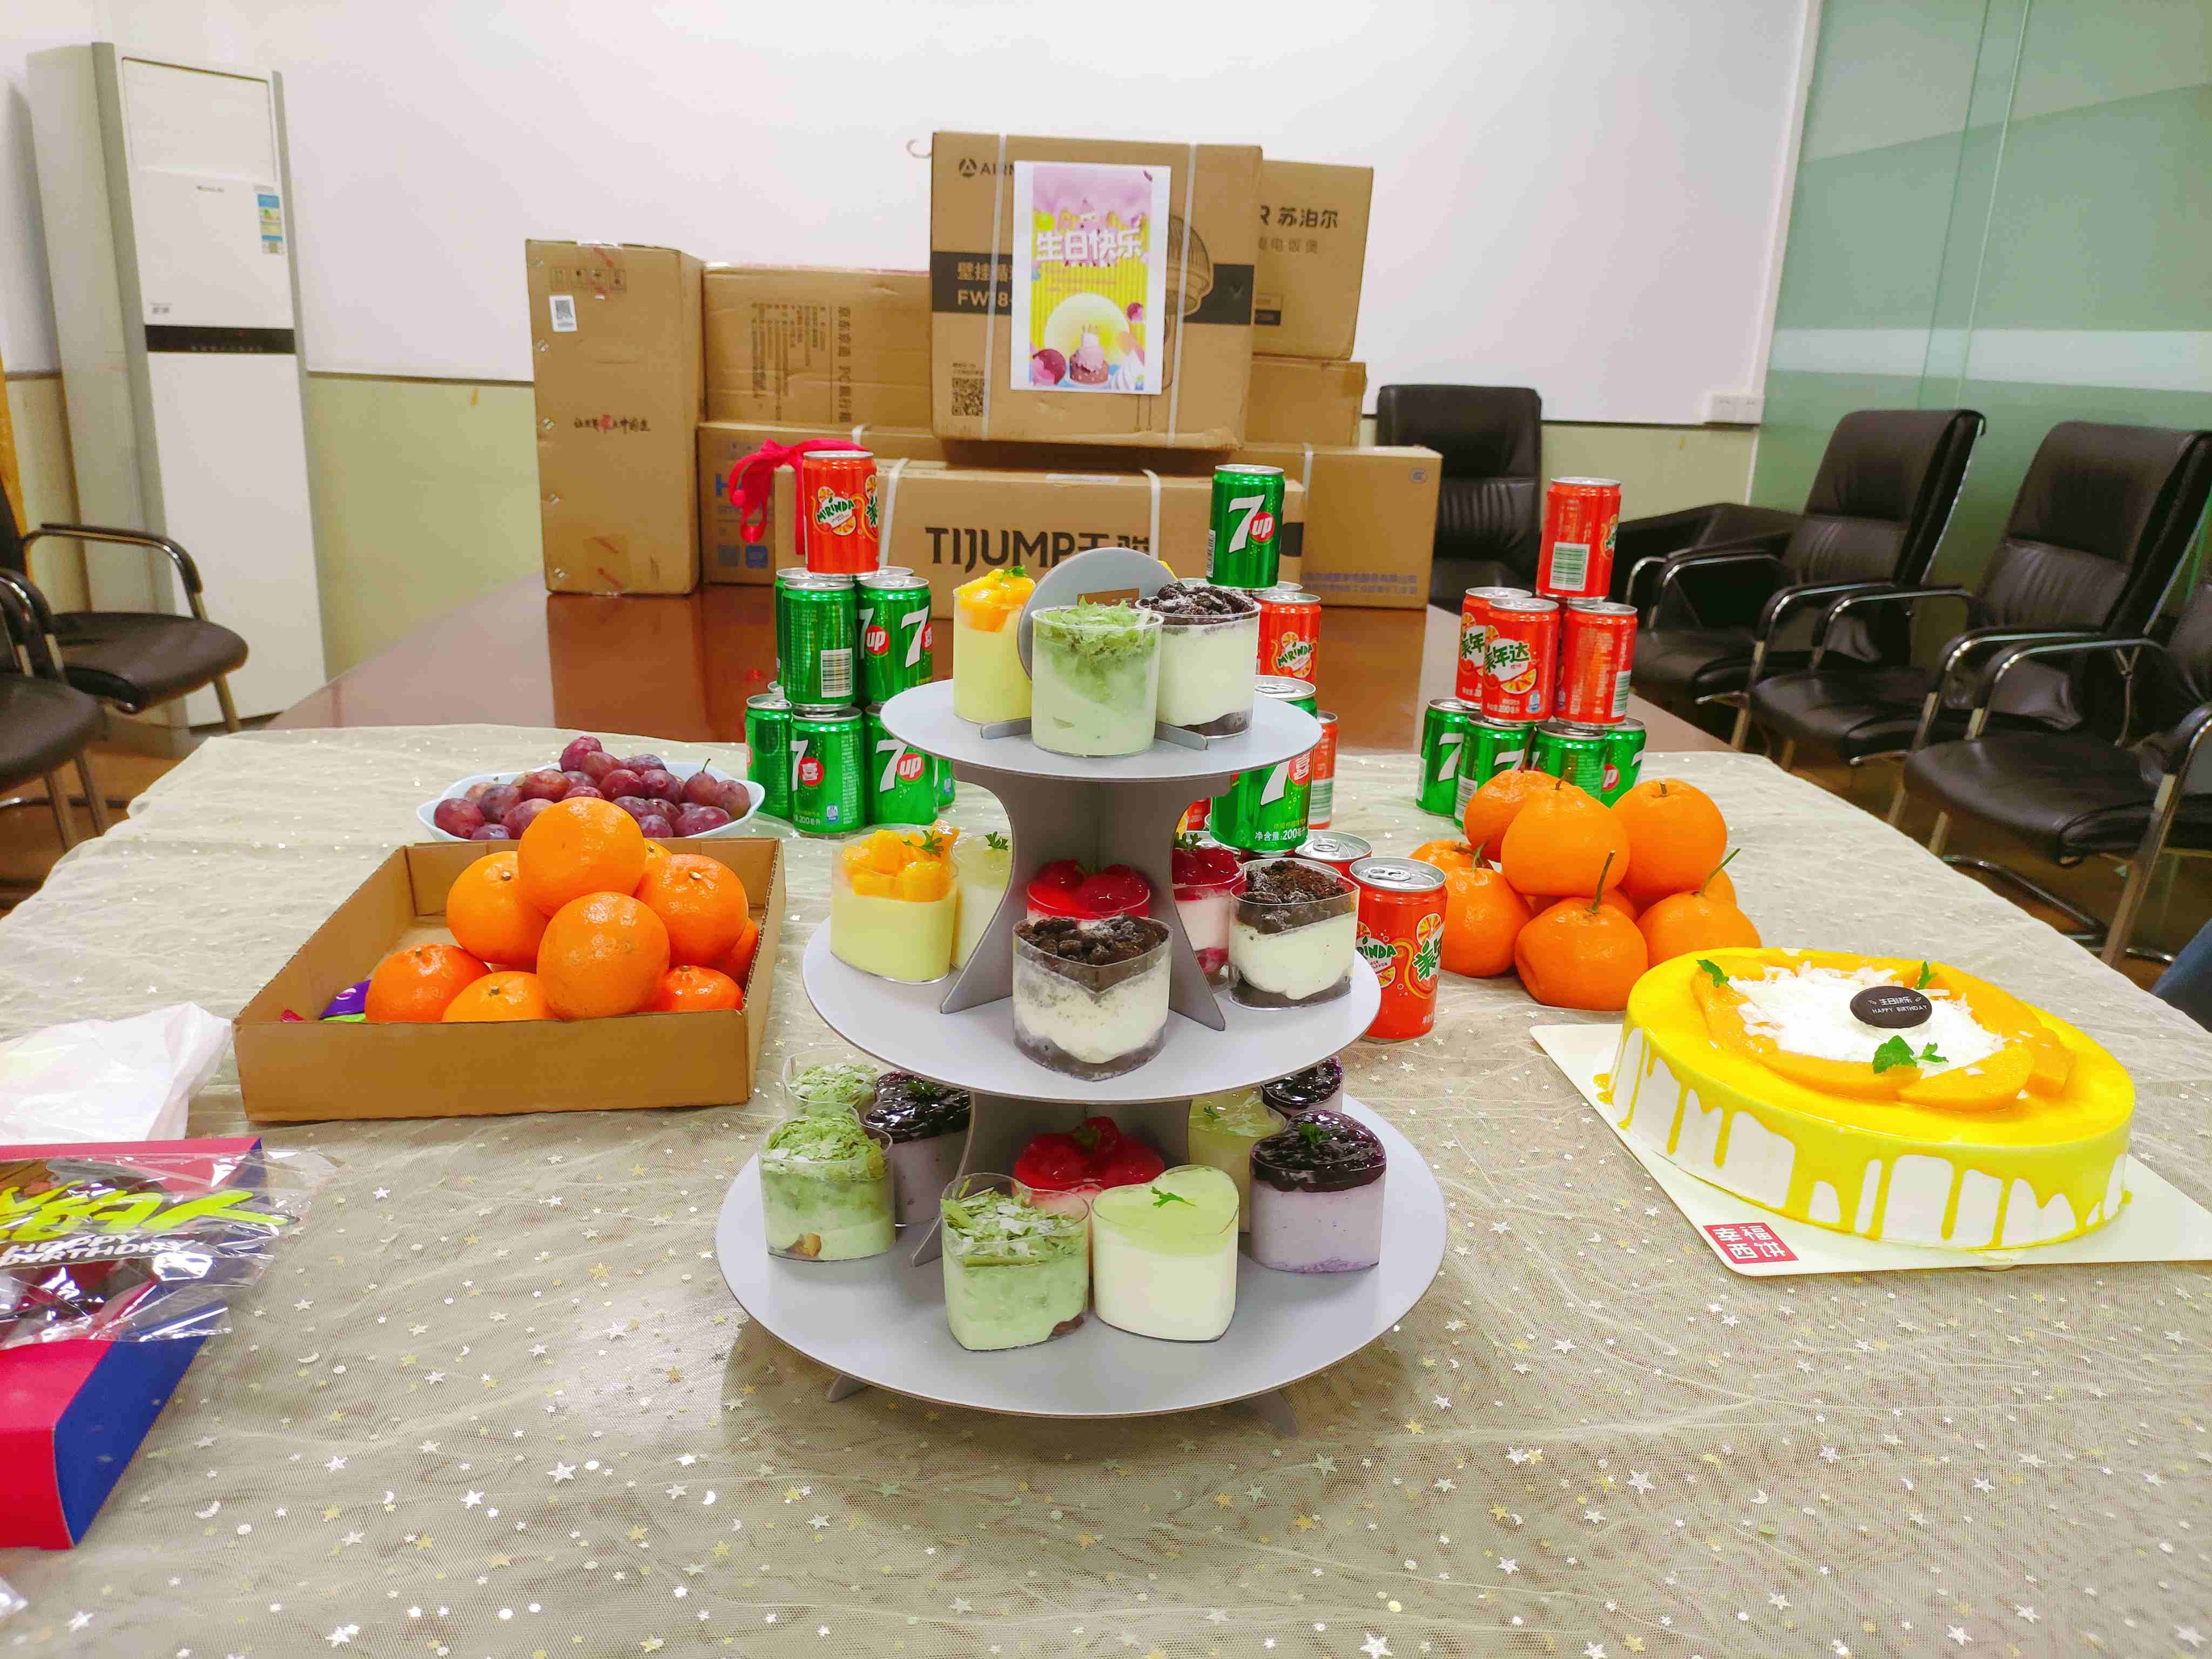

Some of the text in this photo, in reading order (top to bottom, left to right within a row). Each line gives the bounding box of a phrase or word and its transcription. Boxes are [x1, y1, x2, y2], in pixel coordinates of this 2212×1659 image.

[1278, 207, 1339, 230] 苏泊尔
[1036, 227, 1142, 261] 生日快乐
[817, 495, 855, 522] MIRINDA
[1897, 1004, 1927, 1013] BIRTHDAY
[1712, 1225, 1773, 1243] 幸福
[1726, 1241, 1787, 1259] 西饼
